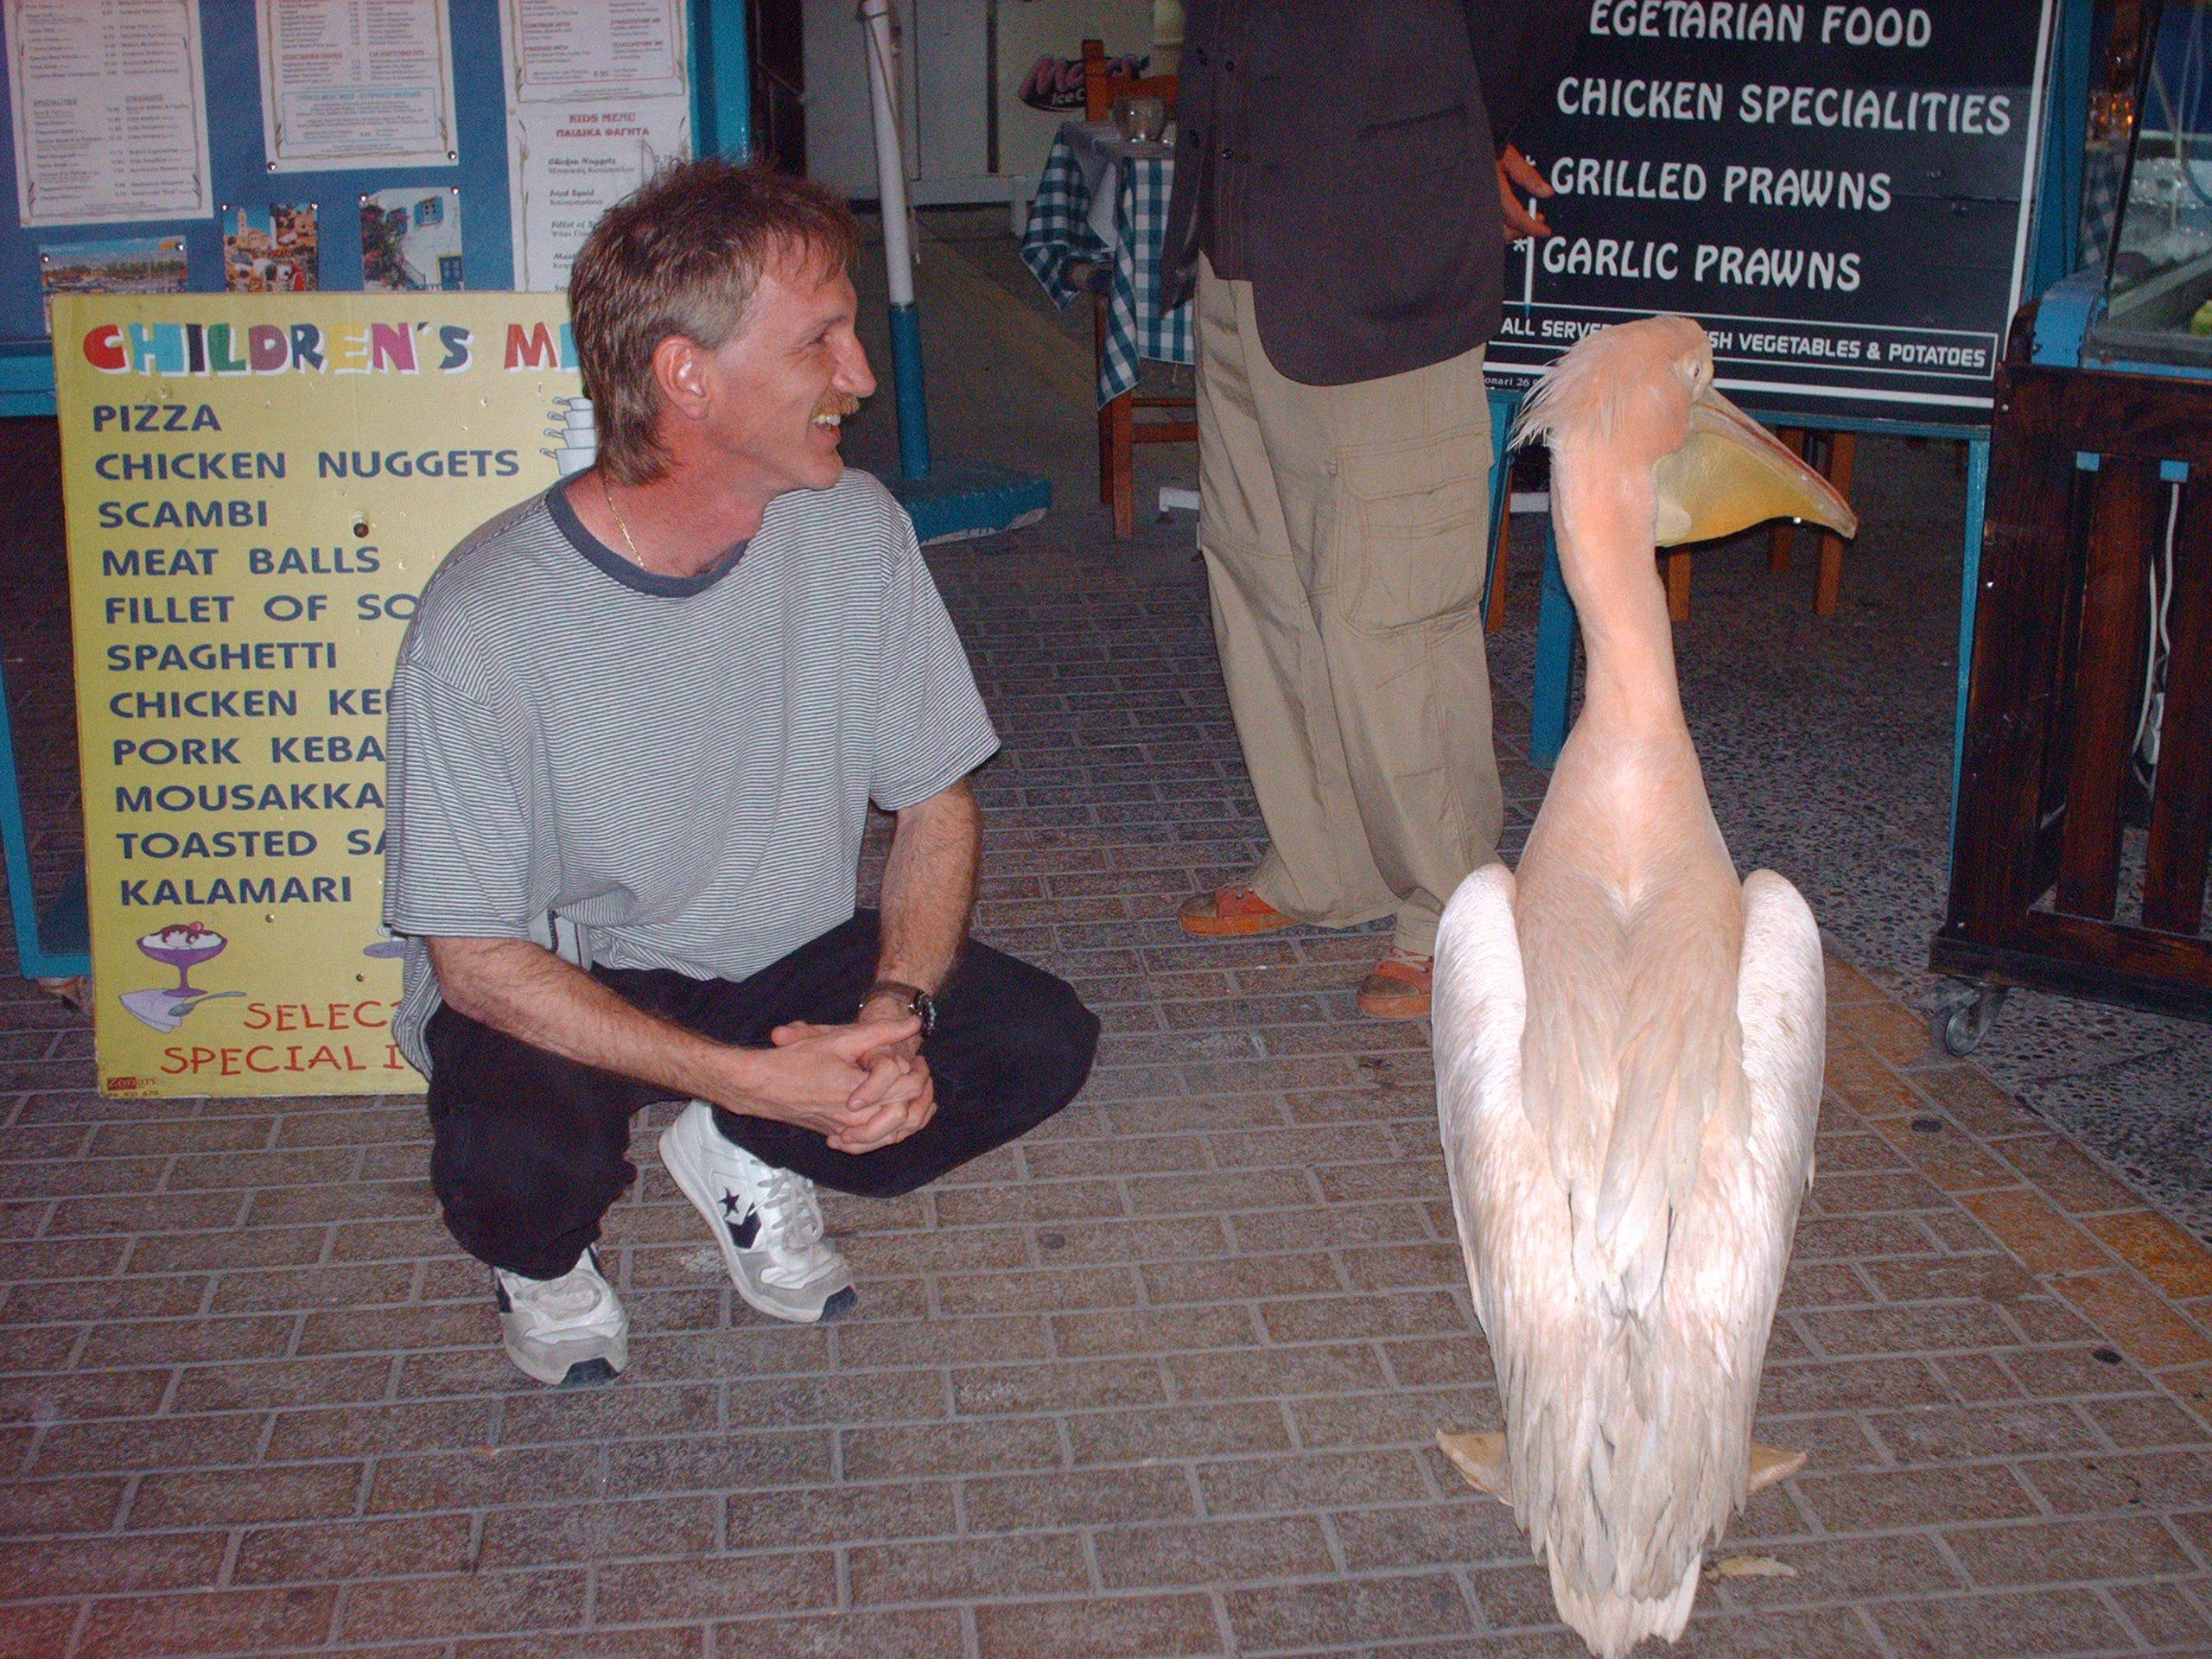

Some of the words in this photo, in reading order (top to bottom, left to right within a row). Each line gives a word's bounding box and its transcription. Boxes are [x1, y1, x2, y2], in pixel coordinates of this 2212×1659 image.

[1591, 0, 1803, 41] EGETARIAN
[1822, 7, 1930, 46] FOOD
[569, 113, 598, 124] KIDS
[601, 112, 636, 123] MENU
[1556, 76, 1723, 119] CHICKEN
[1740, 85, 2010, 134] SPECIALITIES
[556, 128, 602, 138] ΠΑΙΔΙΚΑ
[1552, 158, 1706, 200] GRILLED
[1725, 167, 1890, 210] PRAWNS
[1542, 236, 1679, 280] GARLIC
[1695, 245, 1859, 290] PRAWNS
[83, 321, 474, 378] CHILDREN'S
[1500, 317, 1535, 336] ALL
[1541, 320, 1602, 340] SERVE
[1707, 330, 1733, 349] SH
[1738, 332, 1860, 359] VEGETABLES
[1866, 341, 1881, 360] &
[1889, 343, 1986, 368] POTATOES
[92, 403, 222, 433] PIZZA
[94, 452, 285, 481] CHICKEN
[318, 450, 518, 478] NUGGETS
[97, 500, 267, 529] SCAMBI
[102, 548, 219, 576] MEAT
[249, 546, 379, 575] BALLS
[104, 595, 234, 625] FILLET
[263, 594, 342, 621] OF
[106, 642, 336, 671] SPAGHETTI
[108, 690, 296, 719] CHICKEN
[329, 689, 391, 715] KE
[112, 738, 241, 766] PORK
[115, 782, 385, 813] MOUSAKKA
[115, 830, 317, 860] TOASTED
[118, 876, 351, 906] KALAMARI
[244, 1001, 401, 1031] SELEC
[161, 1045, 367, 1077] SPECIAL
